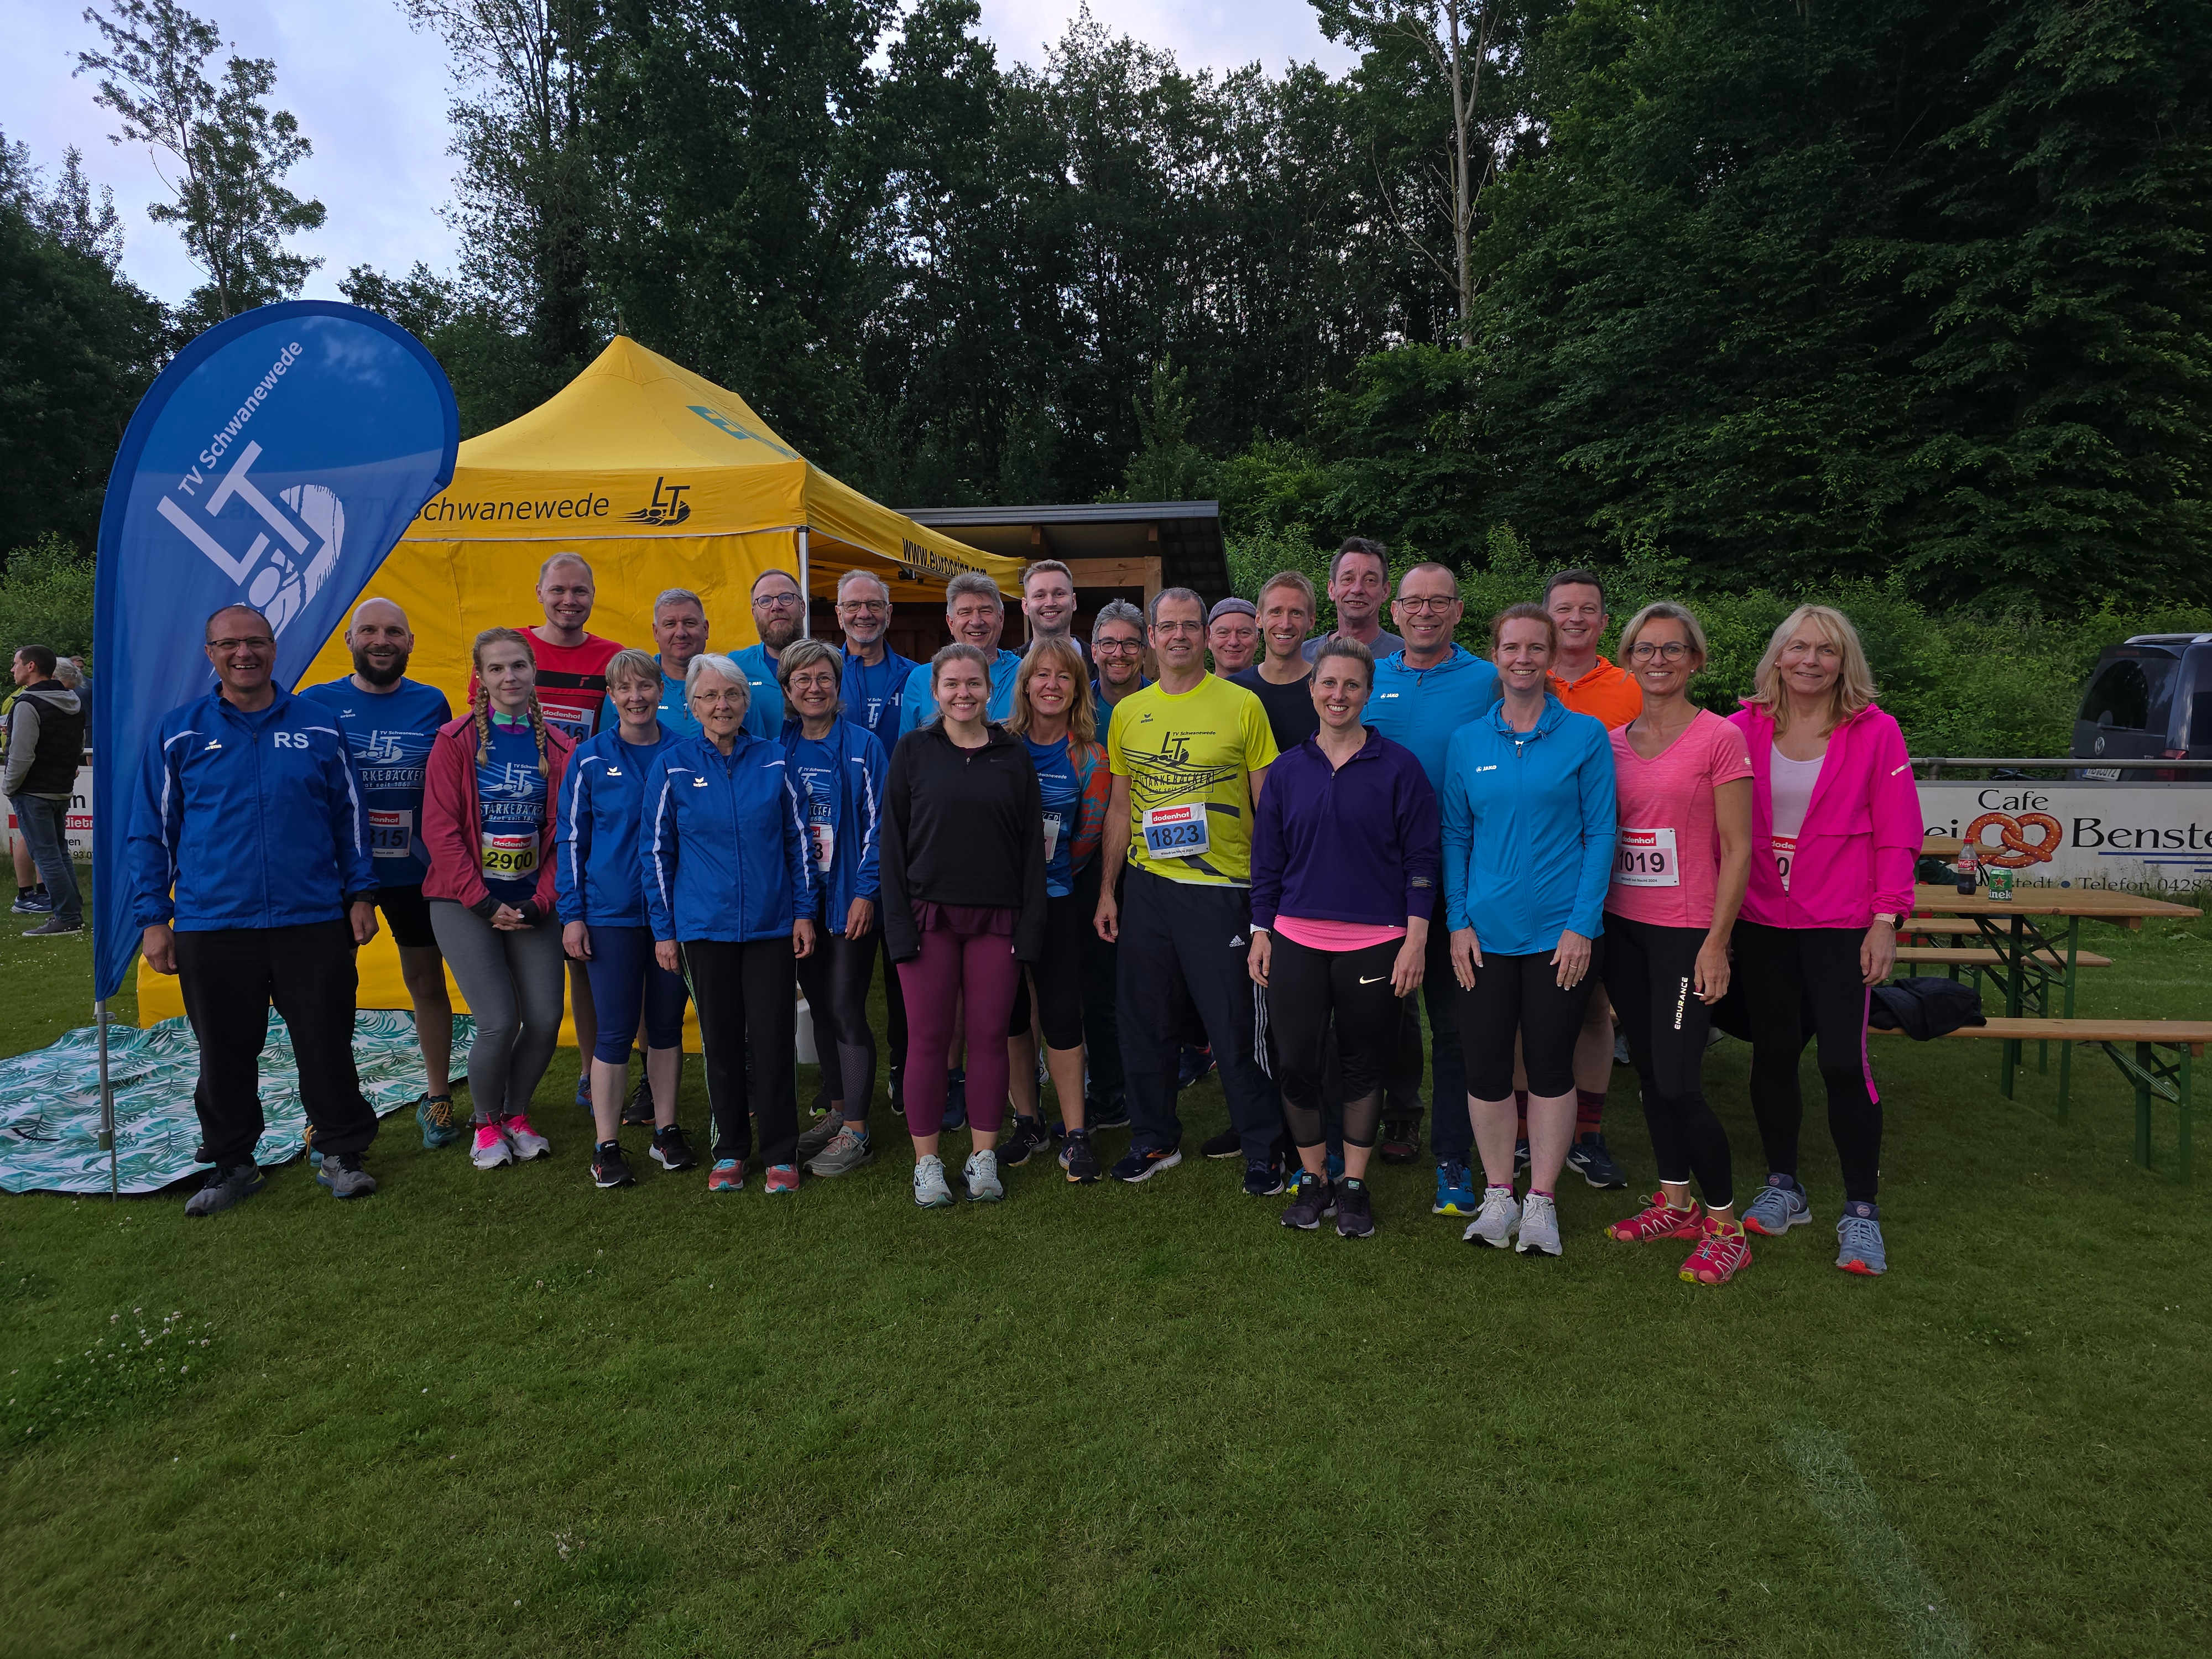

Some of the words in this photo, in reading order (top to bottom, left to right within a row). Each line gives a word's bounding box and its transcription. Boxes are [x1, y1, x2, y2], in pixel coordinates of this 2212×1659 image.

[177, 465, 204, 497] TV
[199, 341, 303, 469] Schwanewede
[156, 440, 310, 587] LT
[274, 732, 309, 749] RS
[67, 794, 86, 809] n
[1978, 789, 2049, 811] Cafe
[1153, 811, 1190, 822] dodenhof
[1151, 825, 1199, 847] 1823
[1771, 840, 1796, 850] dode
[485, 851, 533, 870] 2900
[1619, 850, 1665, 873] 1019
[1776, 857, 1790, 877] 0
[2078, 877, 2150, 892] Telefon
[1674, 977, 1688, 1030] ENDURANCE
